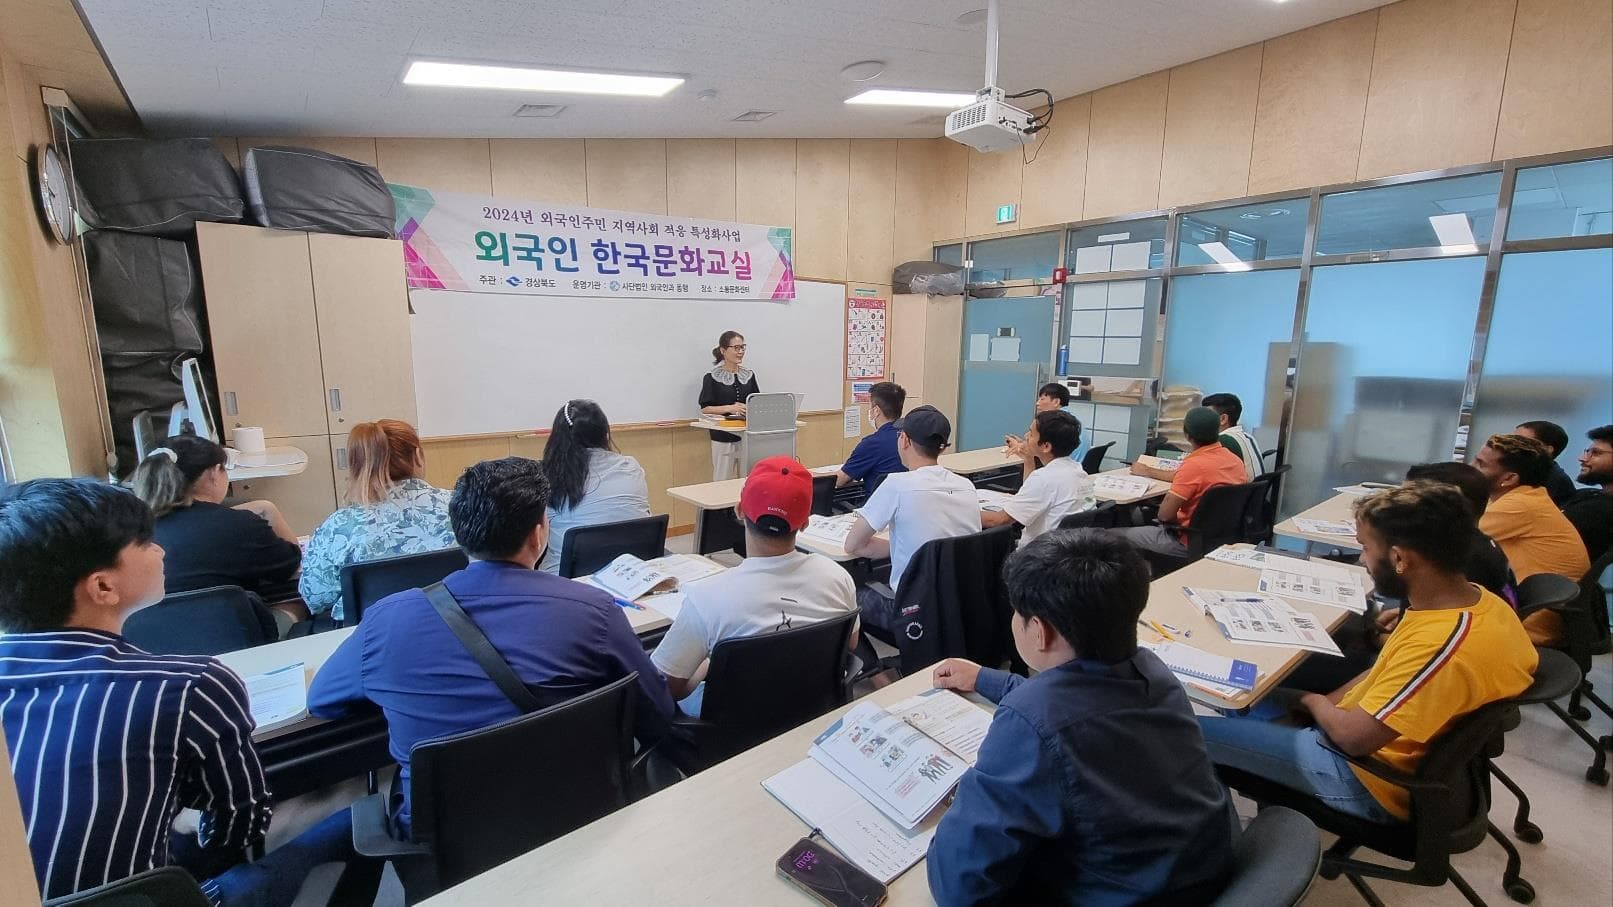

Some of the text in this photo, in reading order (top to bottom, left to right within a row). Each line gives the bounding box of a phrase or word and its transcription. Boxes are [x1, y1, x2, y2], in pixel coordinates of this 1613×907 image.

[482, 206, 741, 242] 2024년 외국인주민 지역사회 적응 특성화사업
[474, 230, 752, 280] 외국인 한국문화교실
[479, 275, 497, 286] 주관
[525, 277, 557, 288] 경상북도
[572, 279, 601, 290] 운영기관
